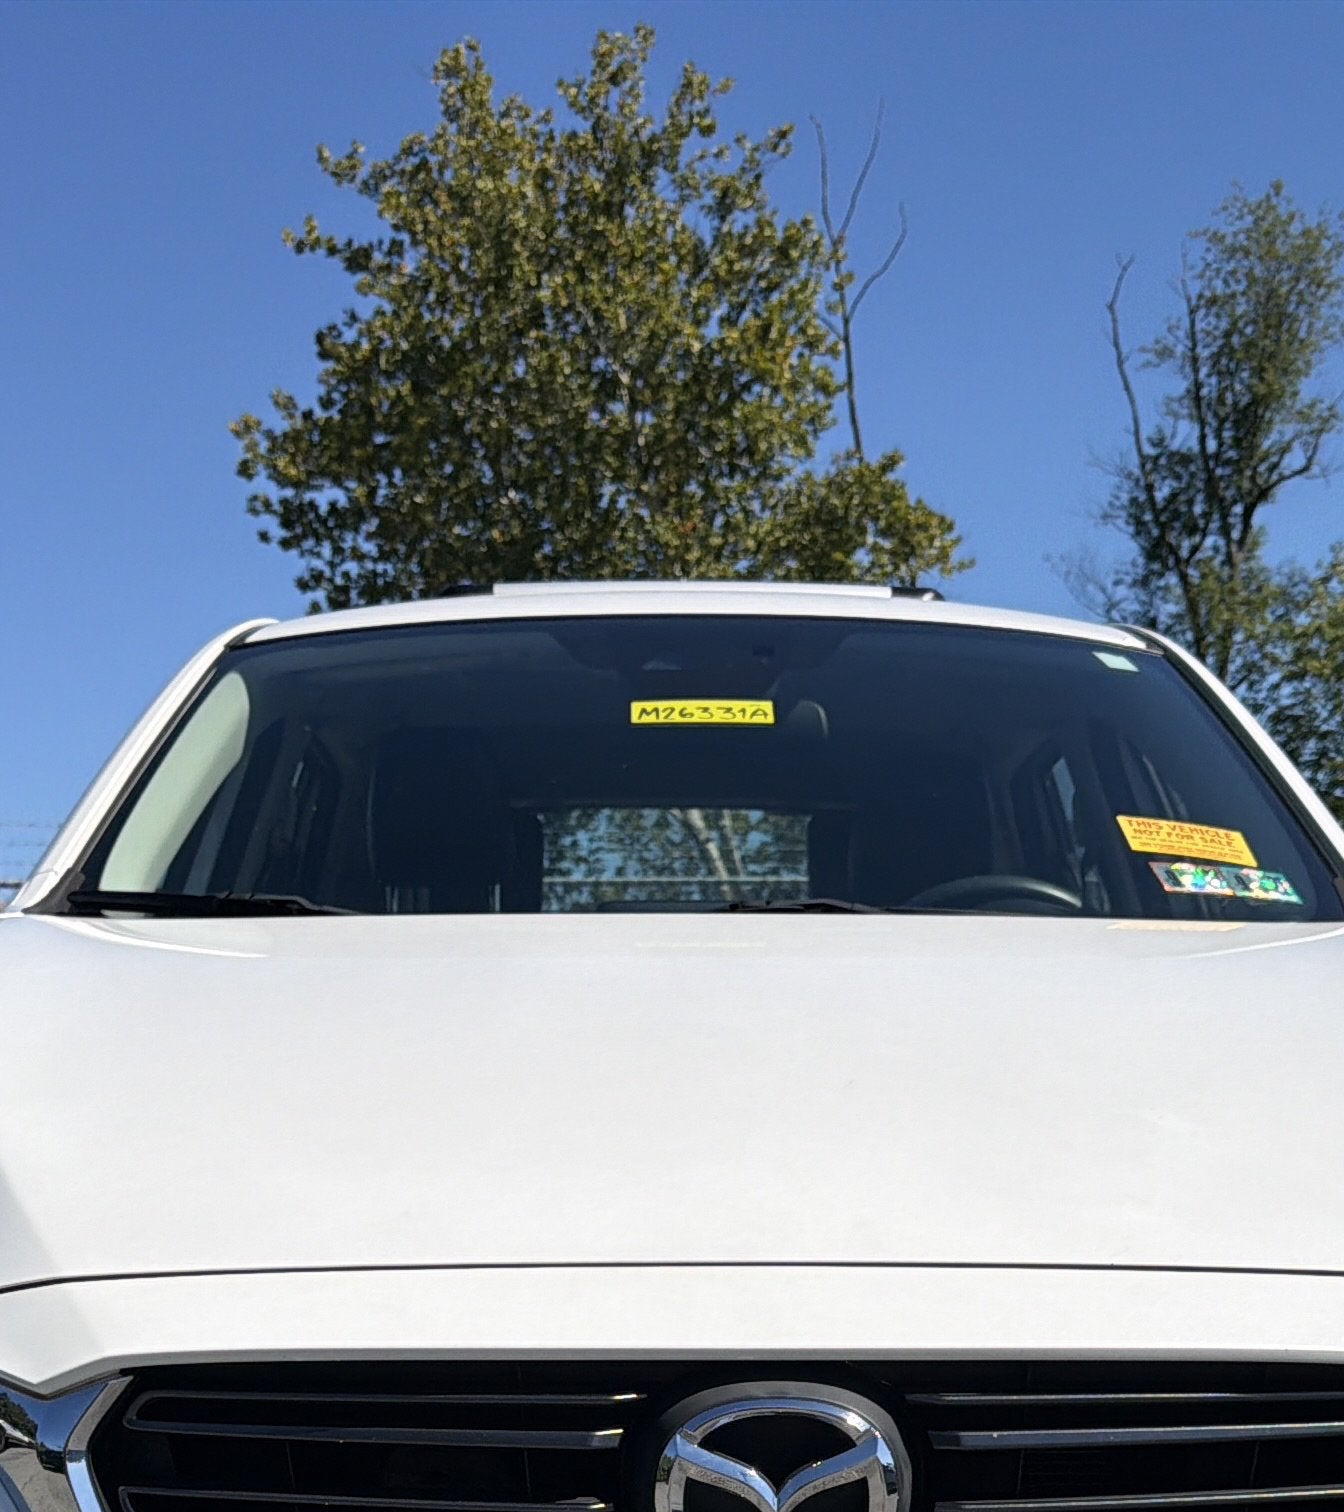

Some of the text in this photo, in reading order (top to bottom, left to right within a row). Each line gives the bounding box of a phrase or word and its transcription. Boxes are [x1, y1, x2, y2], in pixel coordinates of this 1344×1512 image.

[637, 706, 768, 721] M26331A
[1126, 819, 1236, 842] THIS VEHICLE
[1133, 828, 1161, 837] NOT
[1166, 831, 1195, 841] FOR
[1199, 836, 1236, 848] SALE
